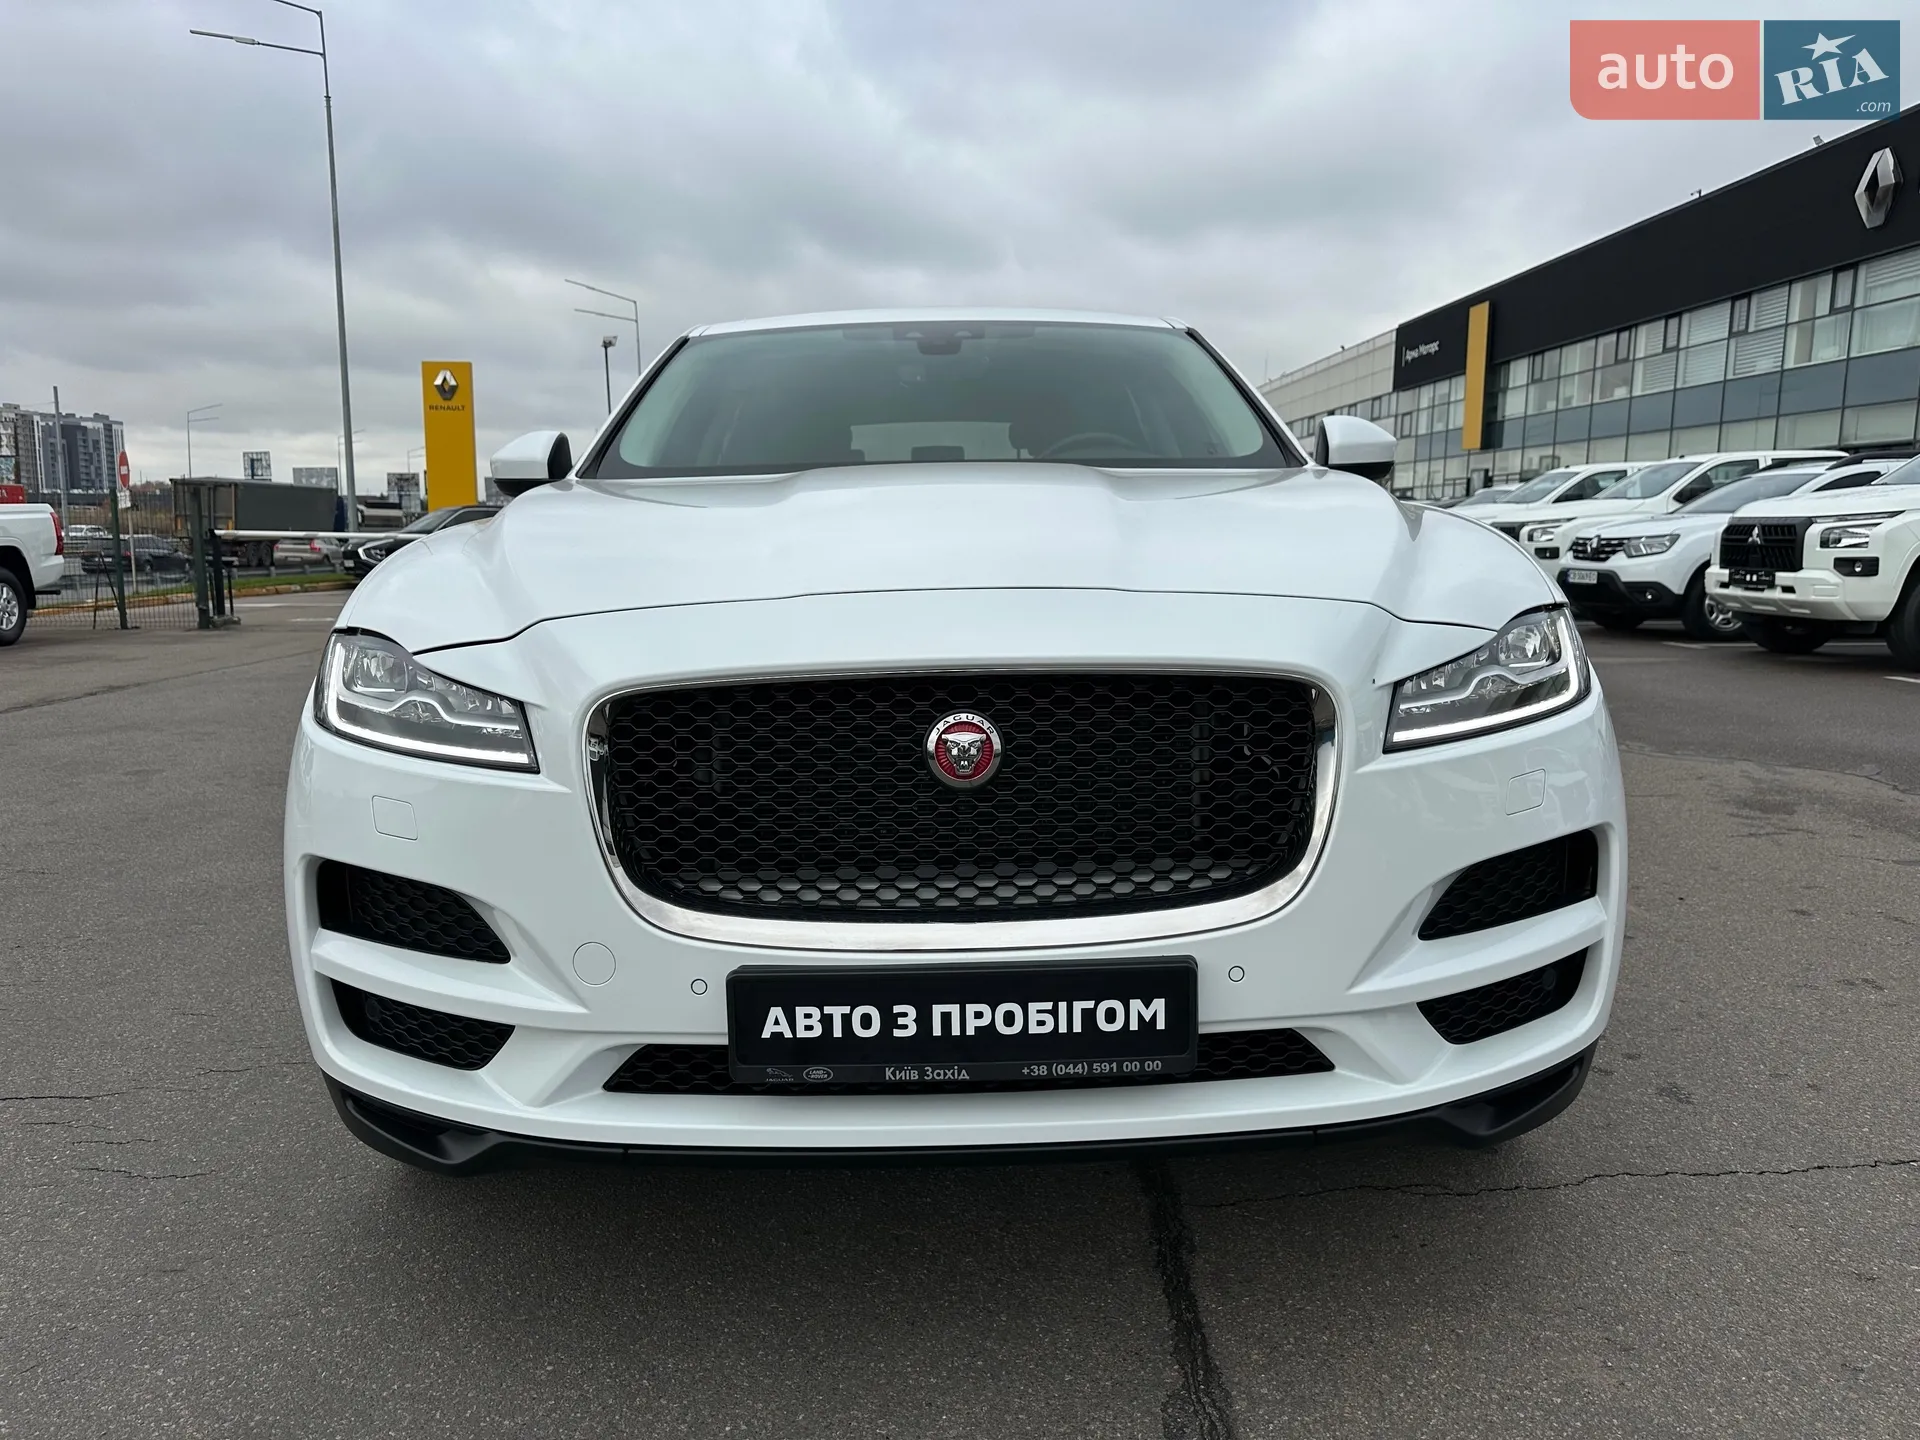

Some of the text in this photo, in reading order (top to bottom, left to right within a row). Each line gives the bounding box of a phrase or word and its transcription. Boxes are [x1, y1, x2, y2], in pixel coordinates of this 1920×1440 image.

[935, 714, 995, 736] JAGUAR
[761, 1005, 881, 1039] АВТО
[931, 998, 1166, 1037] ПРОБІГОМ
[885, 1065, 970, 1081] Київ Захід
[1021, 1060, 1162, 1077] +38 (044) 591 00 00
